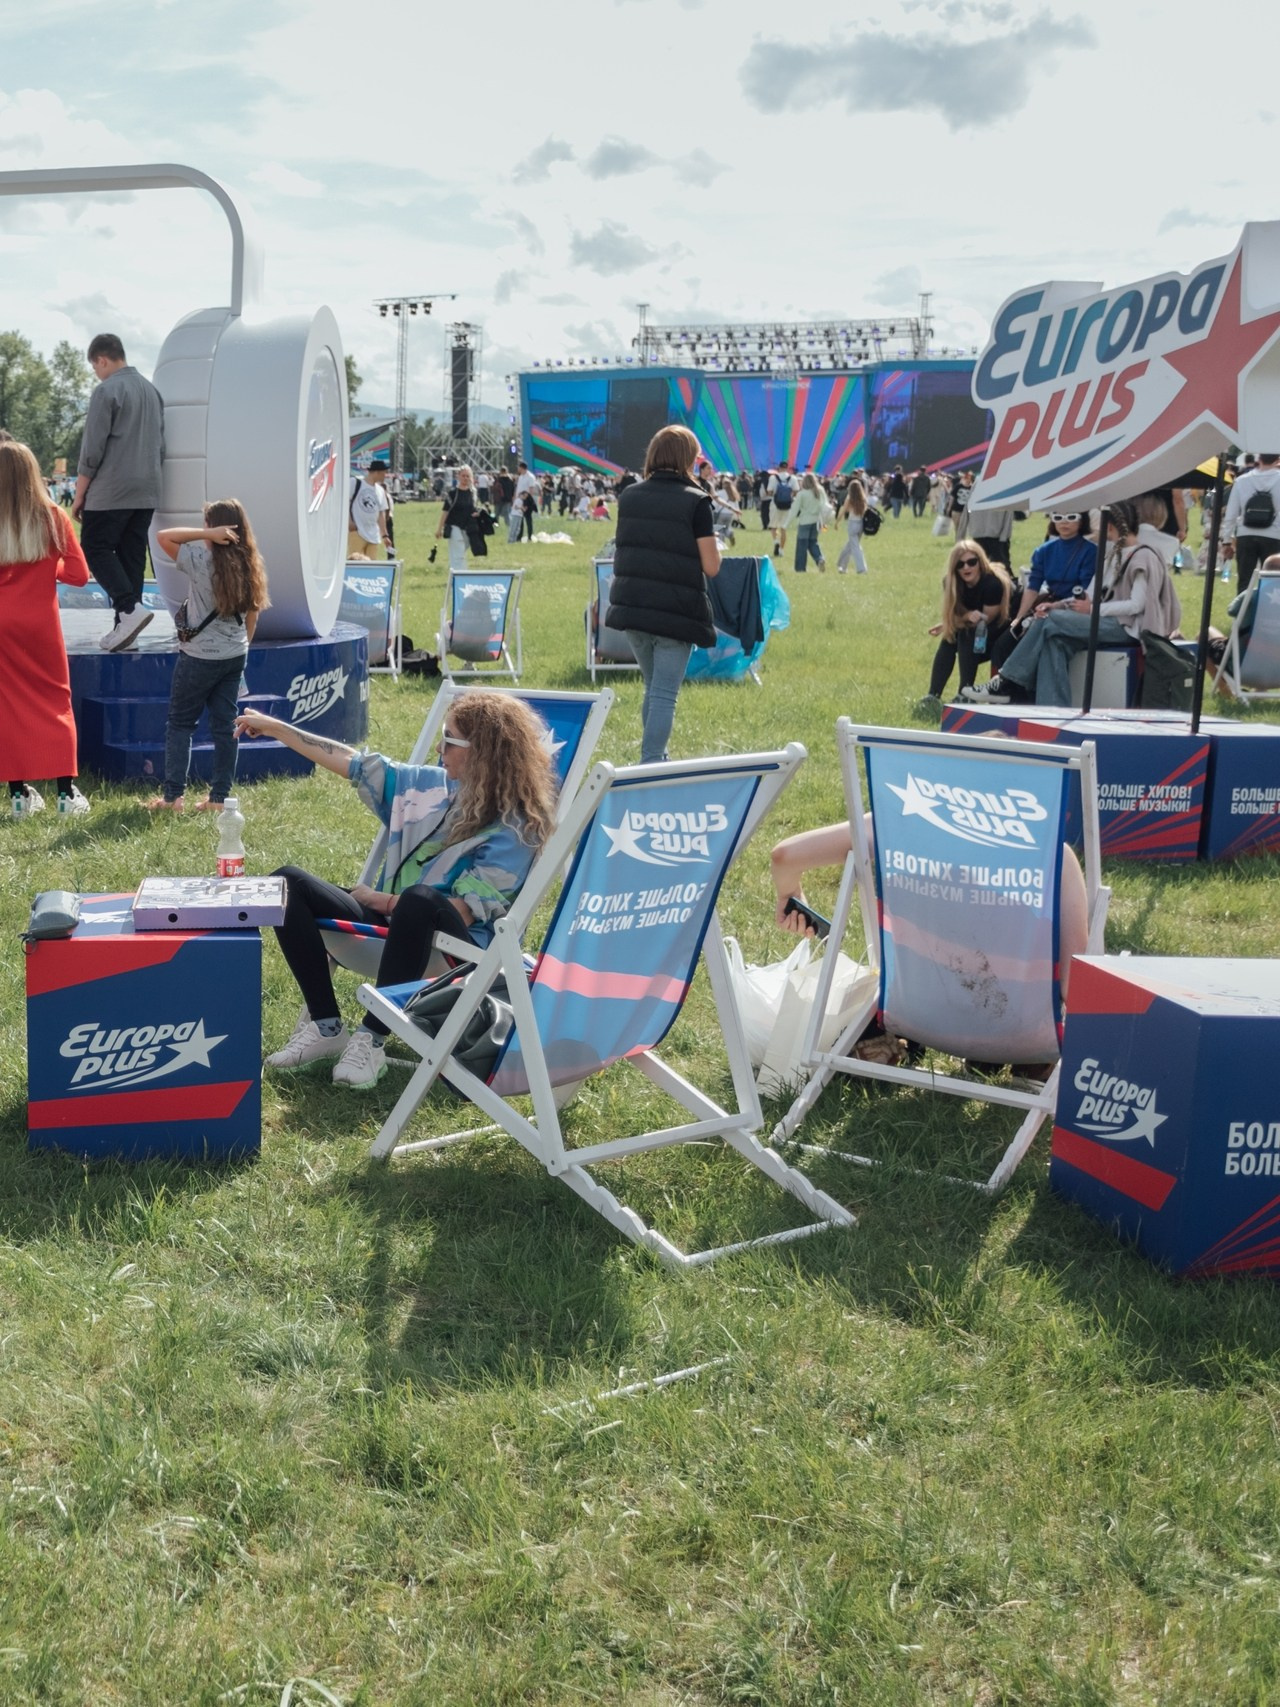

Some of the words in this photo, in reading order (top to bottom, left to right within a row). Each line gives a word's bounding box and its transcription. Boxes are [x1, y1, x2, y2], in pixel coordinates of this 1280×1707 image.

[975, 263, 1227, 401] Europa
[286, 667, 340, 701] Europa
[1097, 799, 1136, 811] ОЛЬШЕ
[1138, 800, 1191, 812] МУЗЫКИ!
[1147, 785, 1193, 799] ХИТОВ!
[1230, 802, 1277, 815] БОЛЬШЕ
[59, 1021, 196, 1058] Europa
[1073, 1058, 1152, 1108] Europa
[1227, 1122, 1280, 1149] БОЛ
